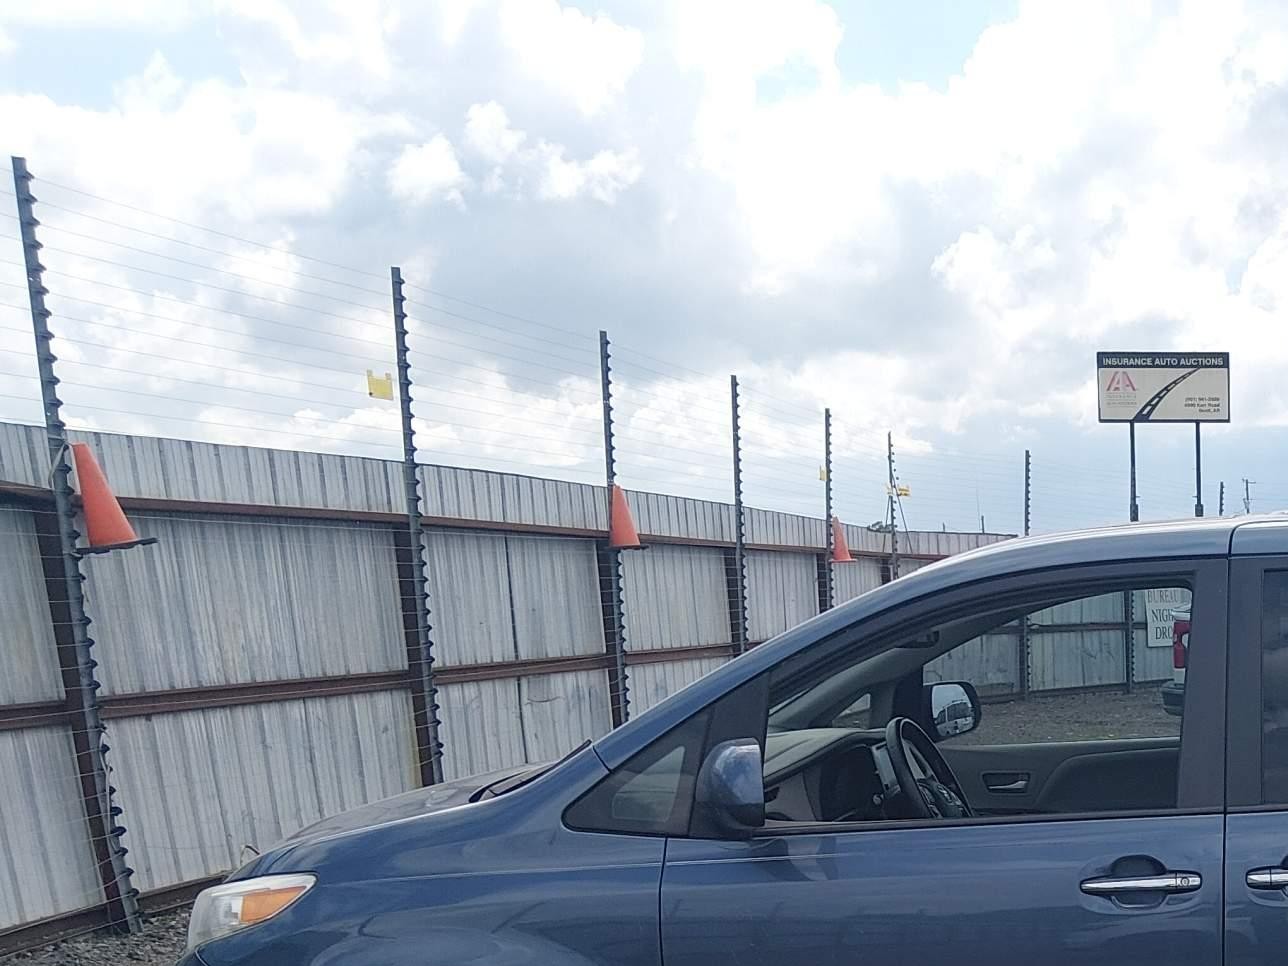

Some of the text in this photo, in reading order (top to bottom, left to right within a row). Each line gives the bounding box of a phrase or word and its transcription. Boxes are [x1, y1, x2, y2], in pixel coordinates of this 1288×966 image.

[1102, 357, 1224, 366] INSURANCE AUTO AUCTIONS
[1151, 608, 1175, 622] NIGH
[1155, 626, 1174, 640] DRO
